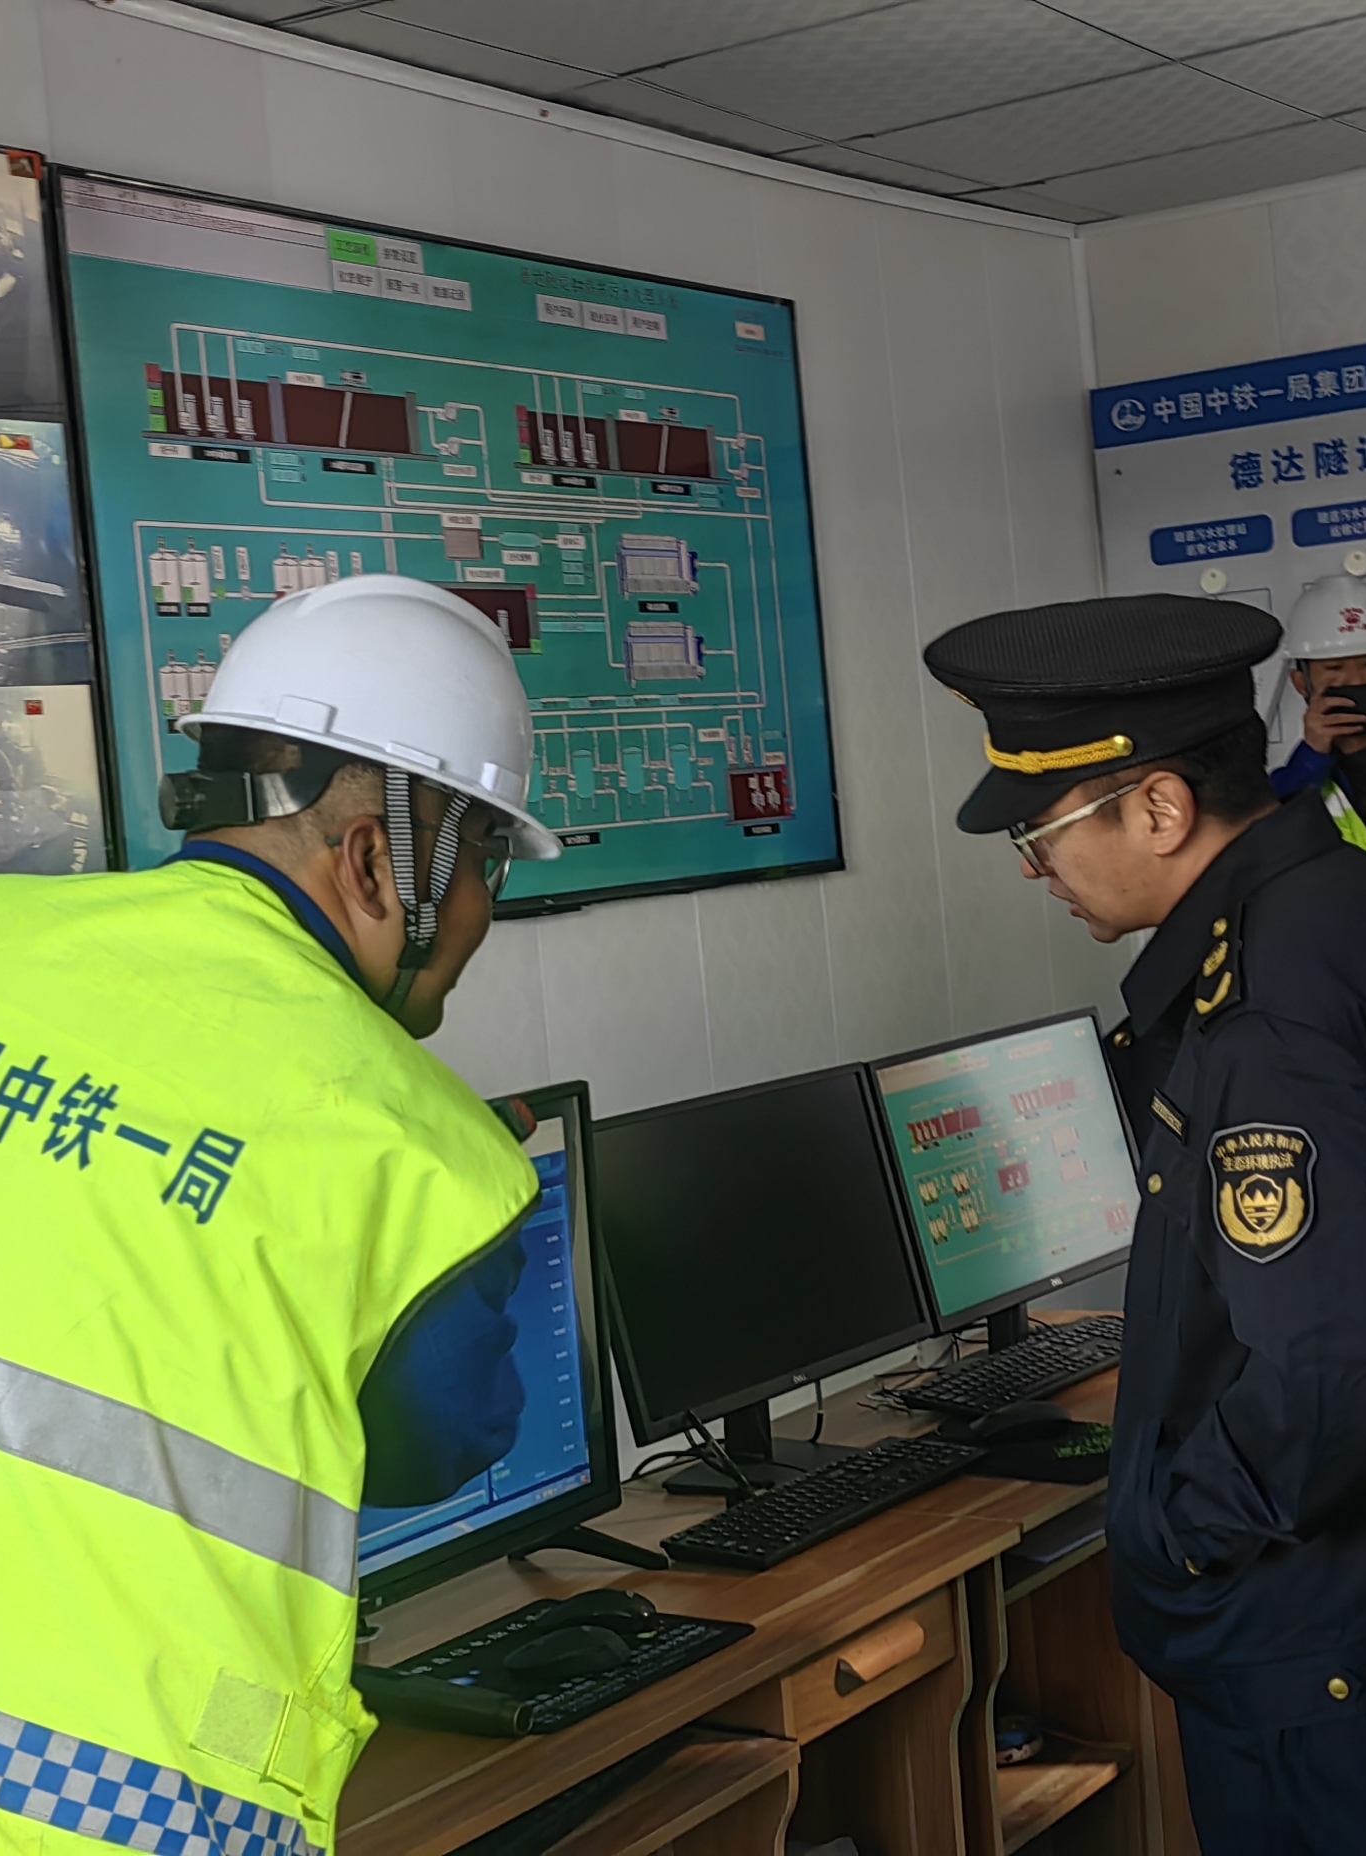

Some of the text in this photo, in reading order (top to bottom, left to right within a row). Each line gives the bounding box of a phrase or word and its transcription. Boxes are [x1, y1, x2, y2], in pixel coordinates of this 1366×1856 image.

[1215, 1132, 1304, 1158] 中华人民共和国
